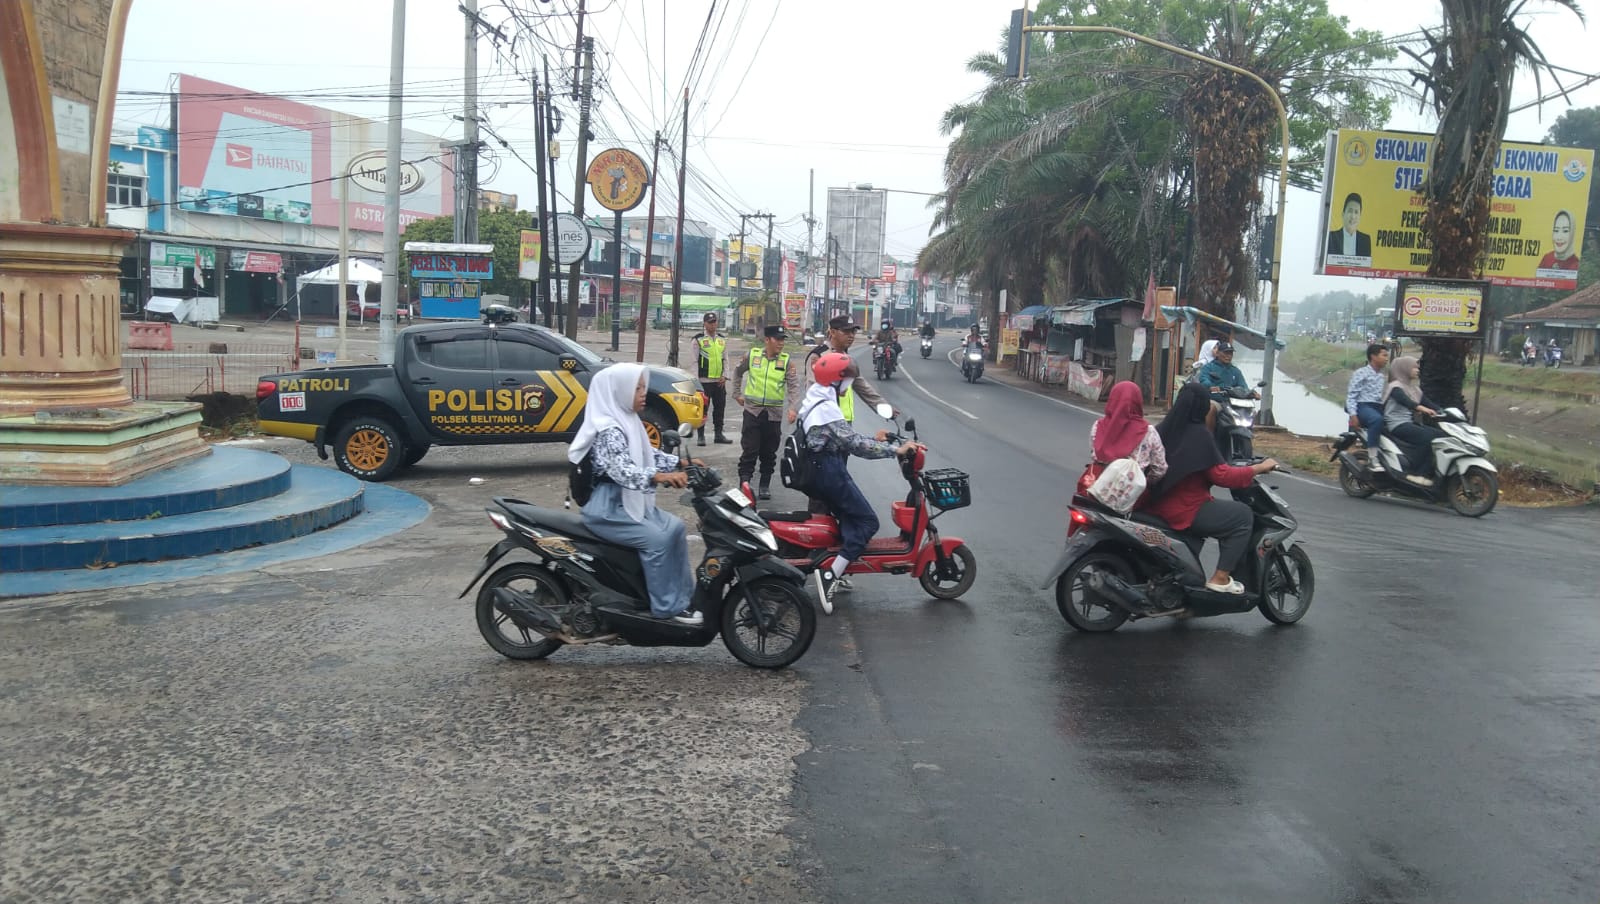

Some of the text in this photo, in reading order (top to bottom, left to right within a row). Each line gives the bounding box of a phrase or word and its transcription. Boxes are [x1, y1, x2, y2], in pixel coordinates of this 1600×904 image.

[257, 153, 307, 174] DAIHATSU
[1374, 138, 1428, 163] SEKOLAH
[1504, 149, 1558, 173] EKONOMI
[1394, 166, 1531, 199] STIE EGARA
[1499, 217, 1521, 235] BARU
[1376, 229, 1415, 248] PROGRAM
[1524, 240, 1541, 256] (S2)
[1425, 298, 1461, 306] ENGLISH
[1425, 305, 1460, 313] CORNER
[279, 378, 350, 392] PATROLI
[282, 397, 304, 408] 110
[428, 389, 522, 412] POLISI
[431, 415, 468, 424] POLSEK
[470, 415, 517, 424] BELITANG
